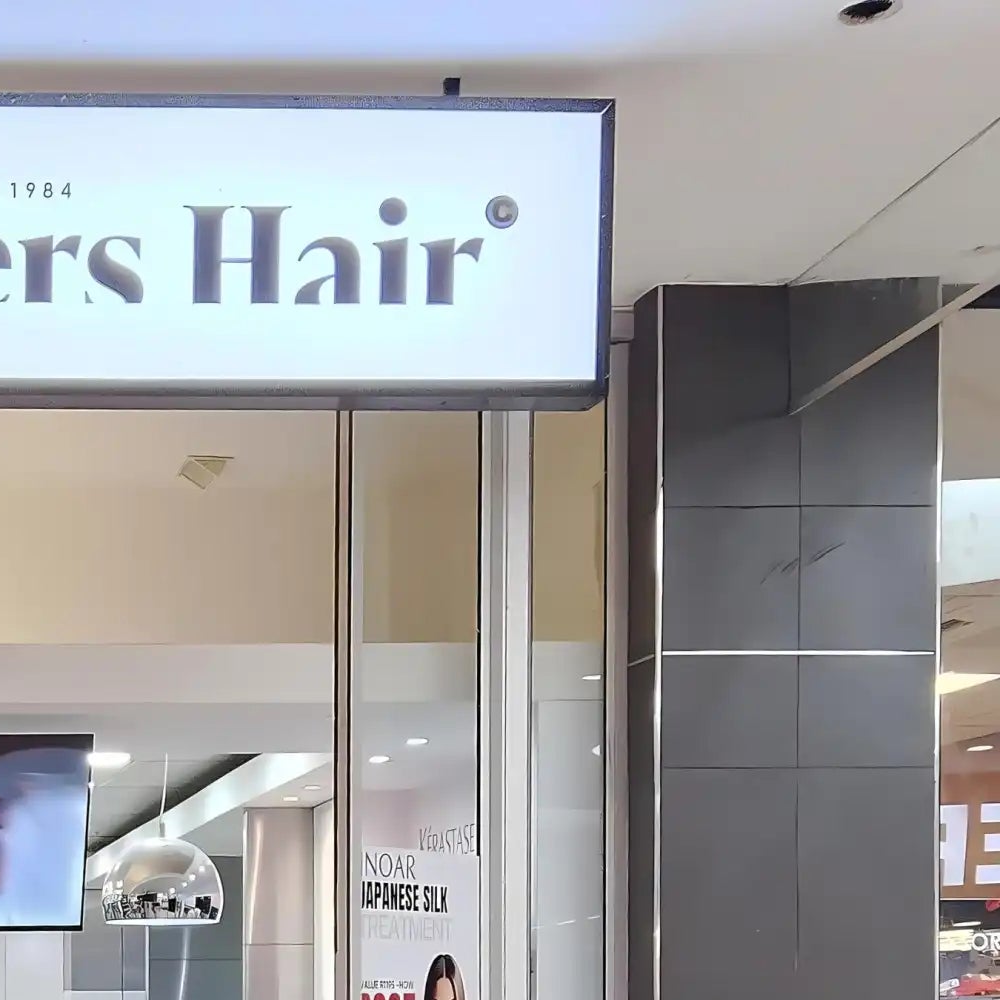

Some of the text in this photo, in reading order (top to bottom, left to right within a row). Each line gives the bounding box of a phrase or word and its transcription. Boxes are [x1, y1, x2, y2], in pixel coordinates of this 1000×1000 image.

[183, 196, 484, 306] Hair
[361, 880, 448, 913] JAPANESE SILK
